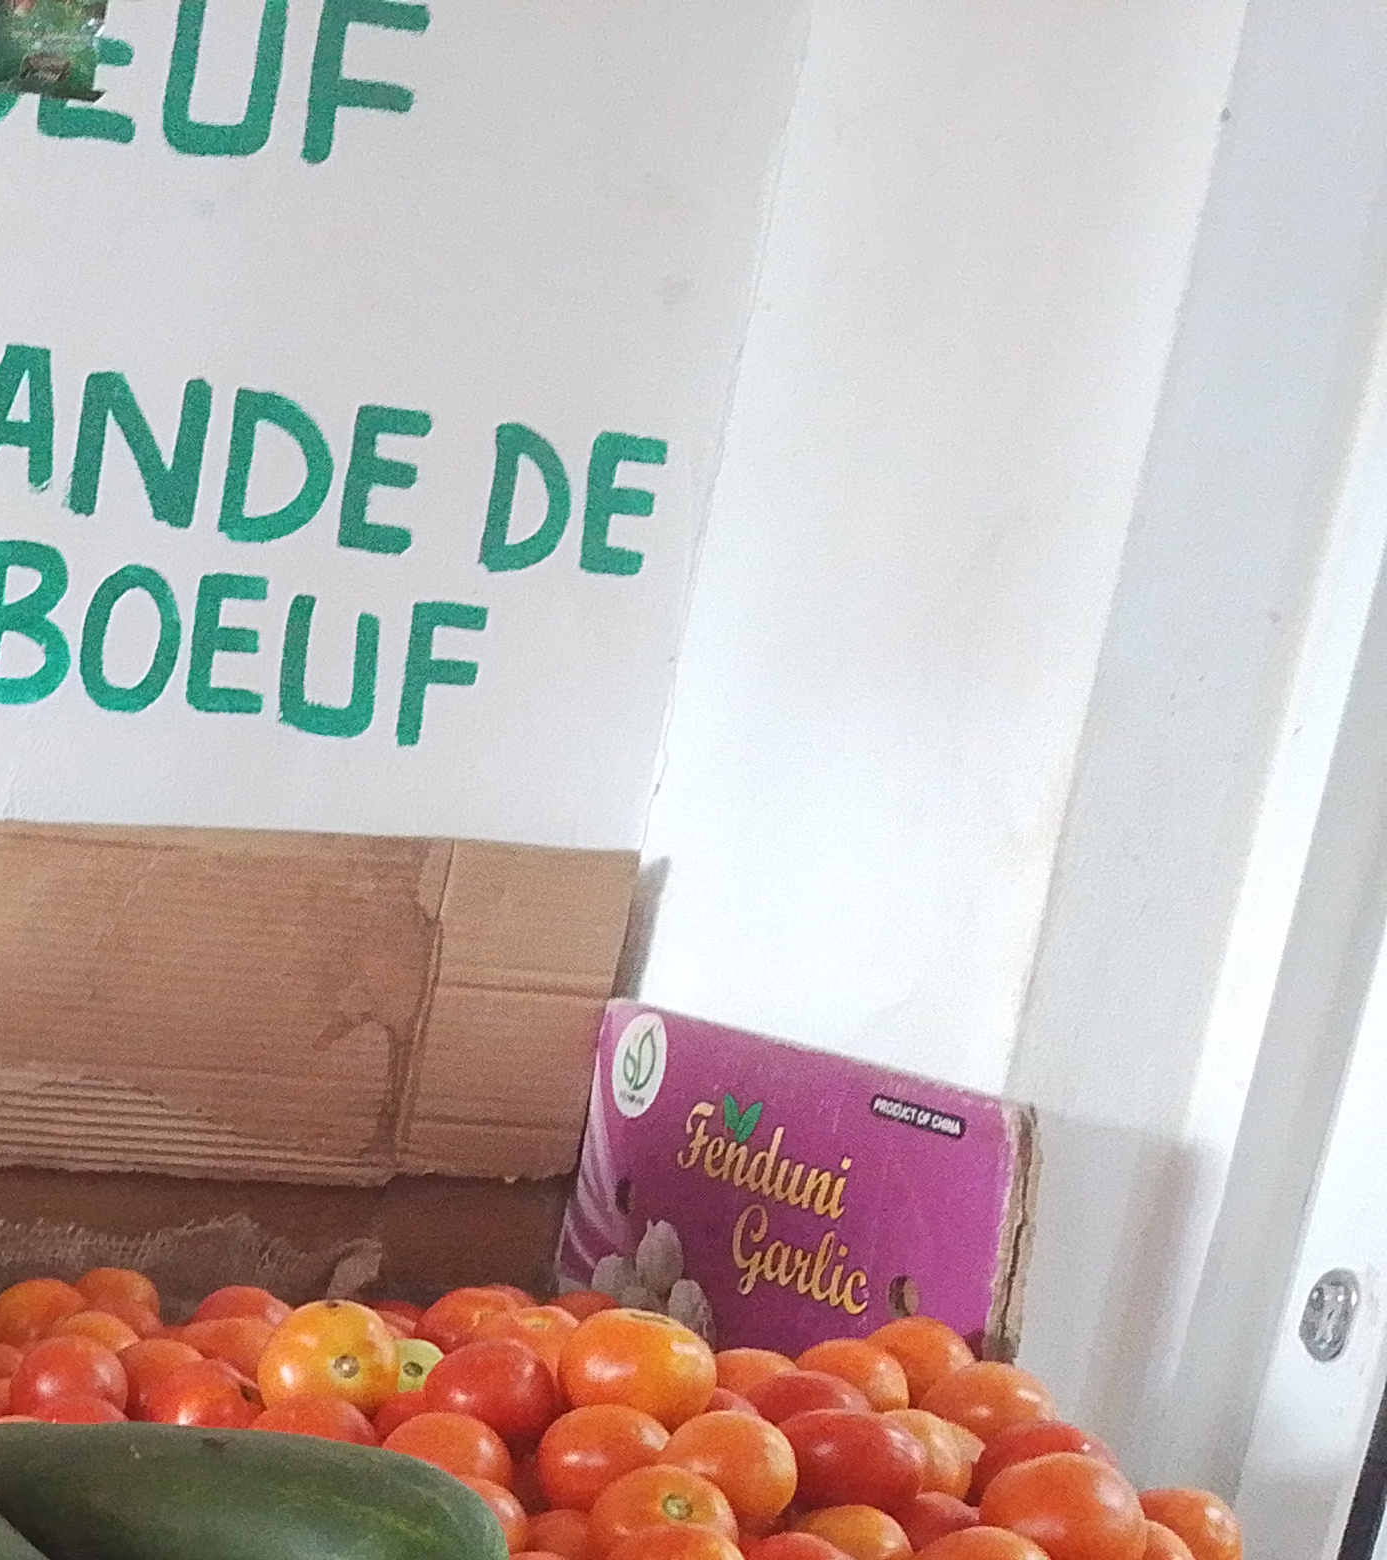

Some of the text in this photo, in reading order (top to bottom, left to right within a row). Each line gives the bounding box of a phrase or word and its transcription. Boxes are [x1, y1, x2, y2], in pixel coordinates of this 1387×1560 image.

[477, 421, 669, 576] DE
[677, 1101, 853, 1220] Fenduni
[931, 1114, 962, 1136] CHINA
[732, 1203, 868, 1316] Garlic
